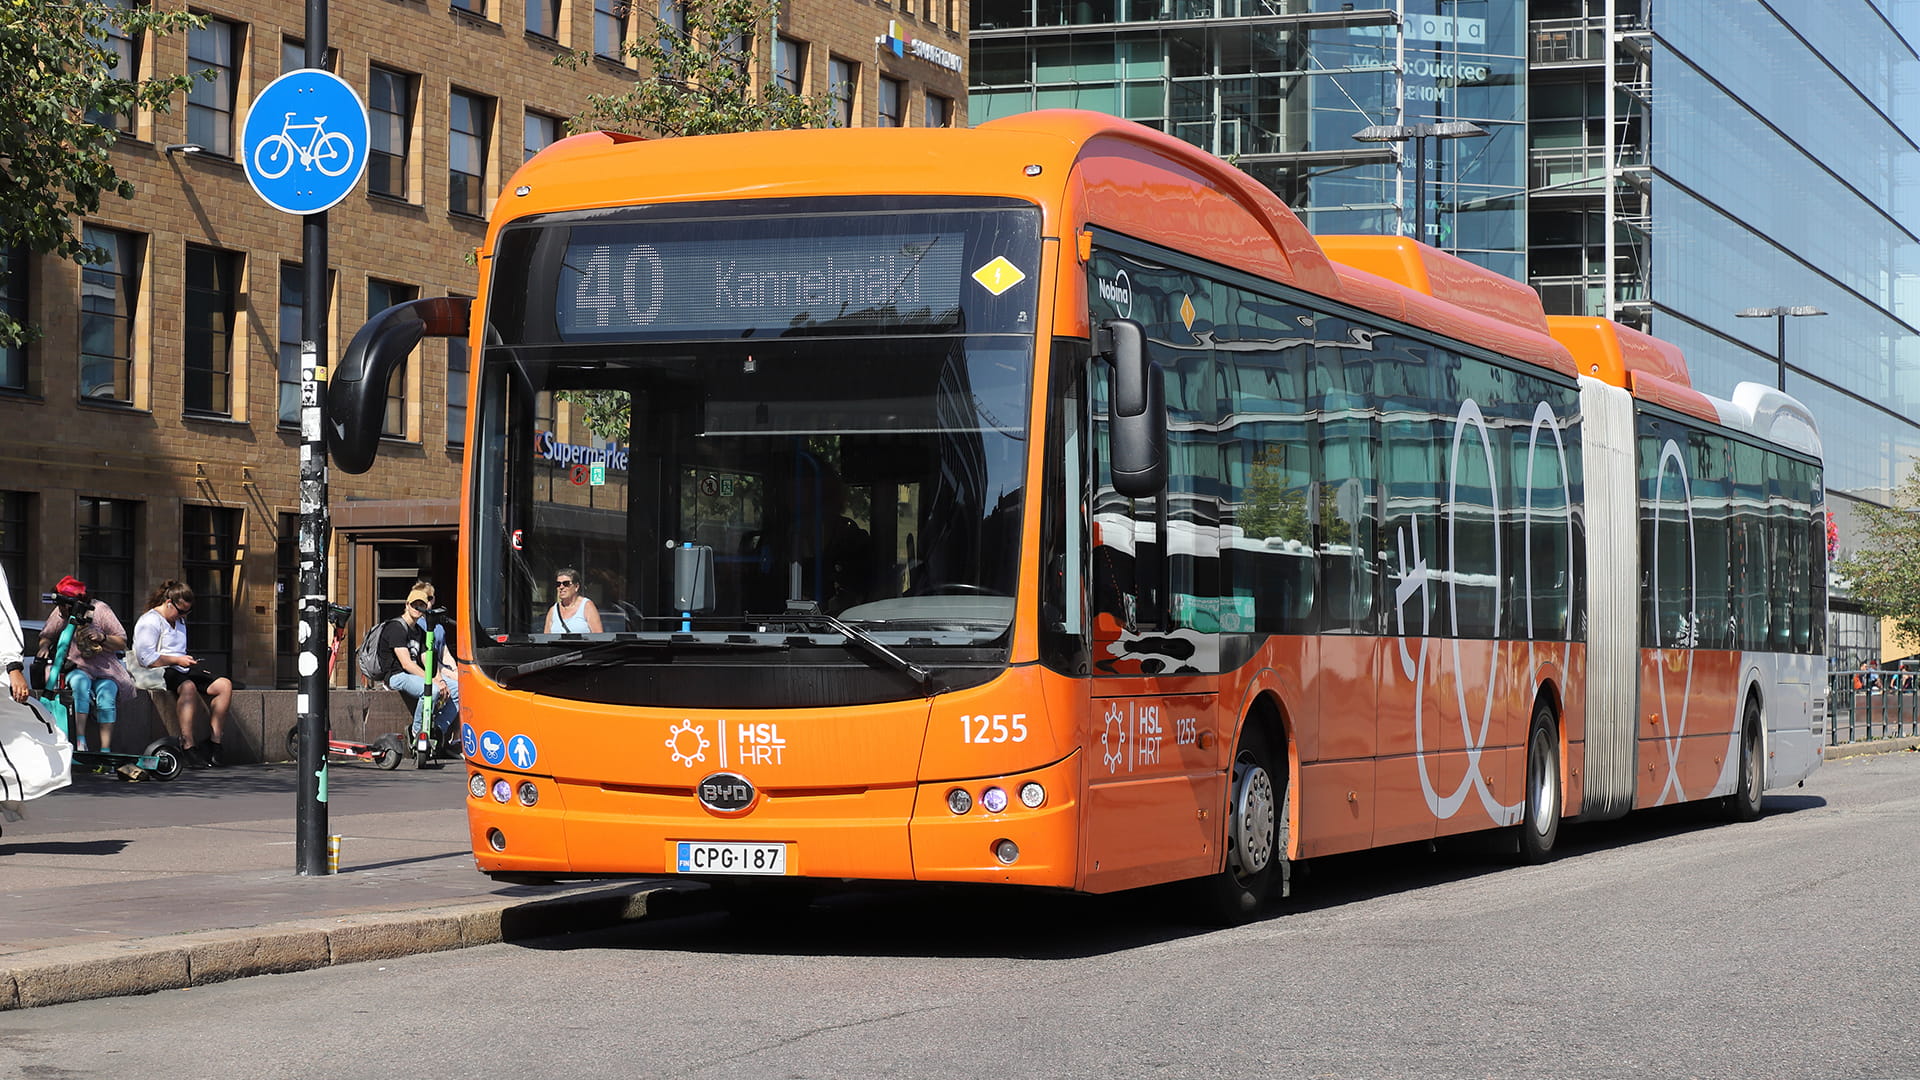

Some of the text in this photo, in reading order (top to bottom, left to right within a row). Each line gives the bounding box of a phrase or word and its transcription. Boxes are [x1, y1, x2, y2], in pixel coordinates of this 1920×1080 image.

[576, 244, 921, 326] 40 Kannelmäki
[1099, 277, 1128, 304] Nobina
[544, 431, 629, 470] Supermarke
[738, 723, 786, 744] HSL
[960, 714, 1028, 743] 1255
[1139, 706, 1162, 734] HSL
[1177, 717, 1196, 745] 1255
[739, 745, 786, 765] HRT
[1139, 737, 1162, 766] HRT
[703, 784, 748, 801] BYD
